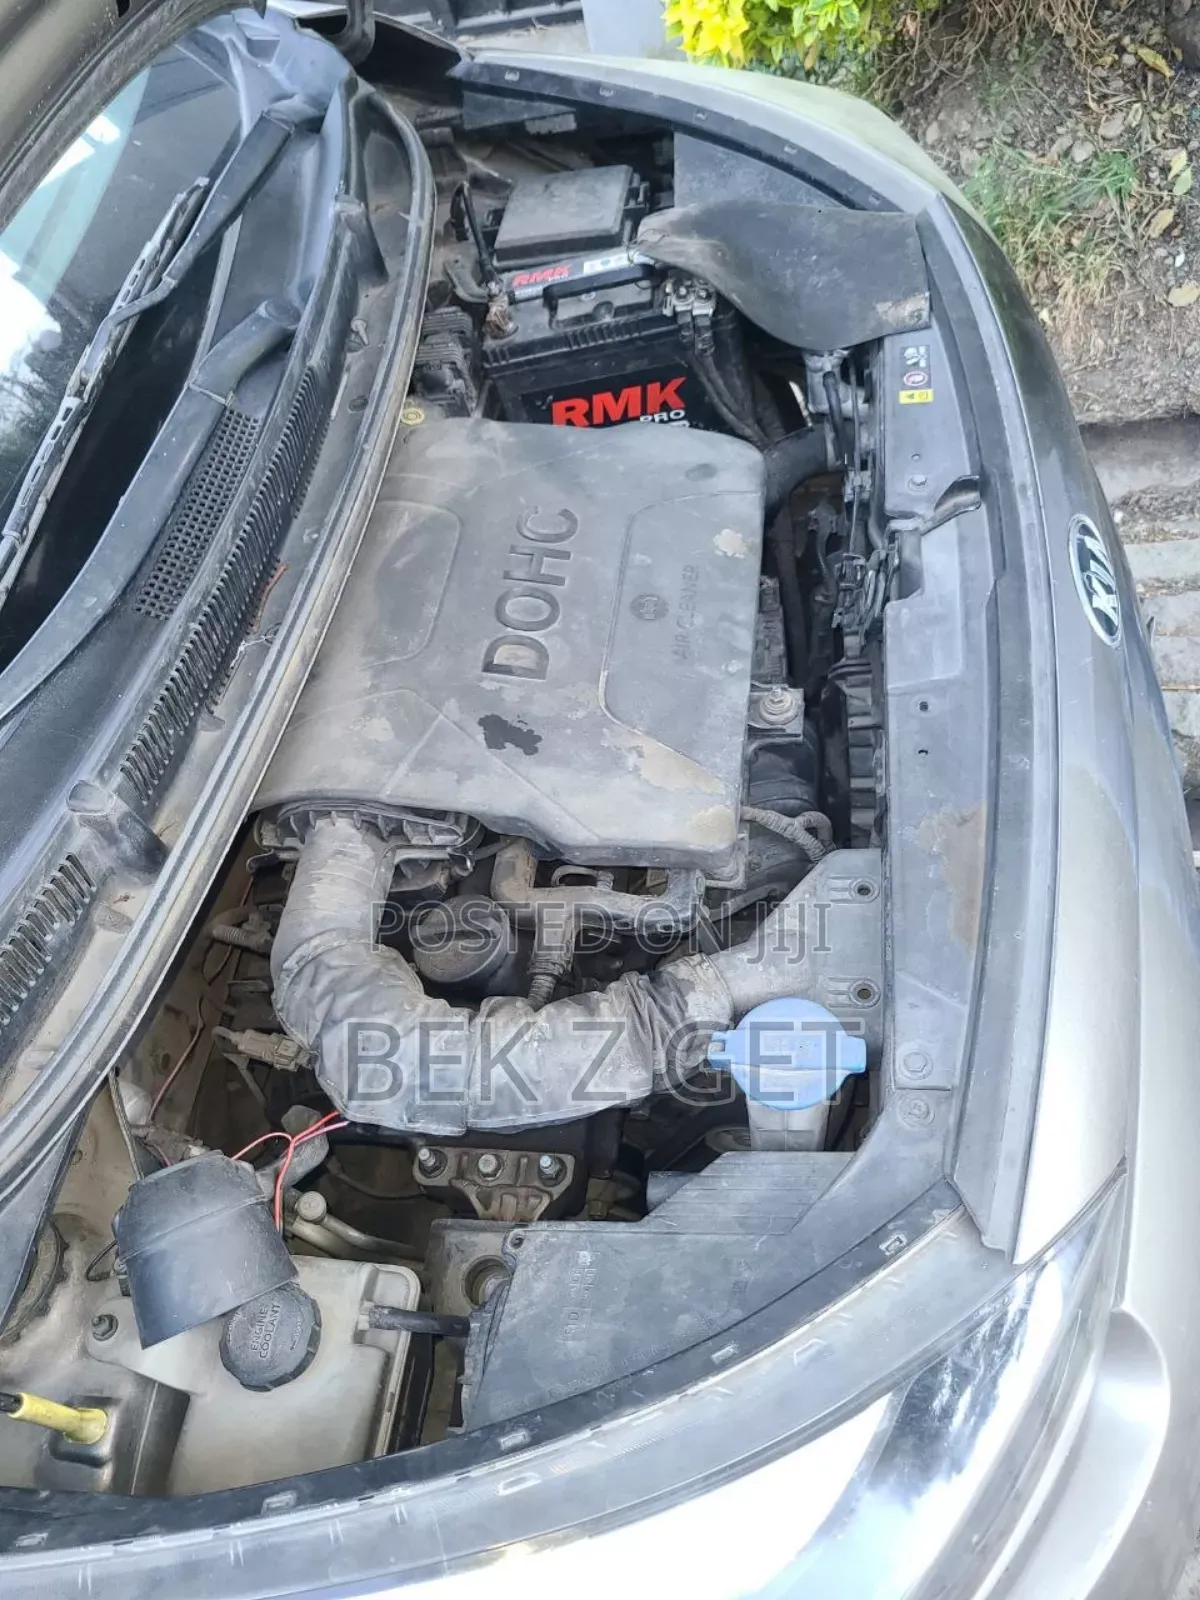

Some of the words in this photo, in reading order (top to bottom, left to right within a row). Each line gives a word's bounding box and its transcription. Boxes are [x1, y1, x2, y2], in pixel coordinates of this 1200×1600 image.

[512, 264, 572, 288] RMK
[552, 376, 687, 427] RMK
[639, 409, 686, 423] PRO
[481, 507, 579, 681] DOHC
[671, 633, 691, 660] AIR
[251, 1307, 269, 1351] ENGINE
[259, 1303, 281, 1359] COOLANT
